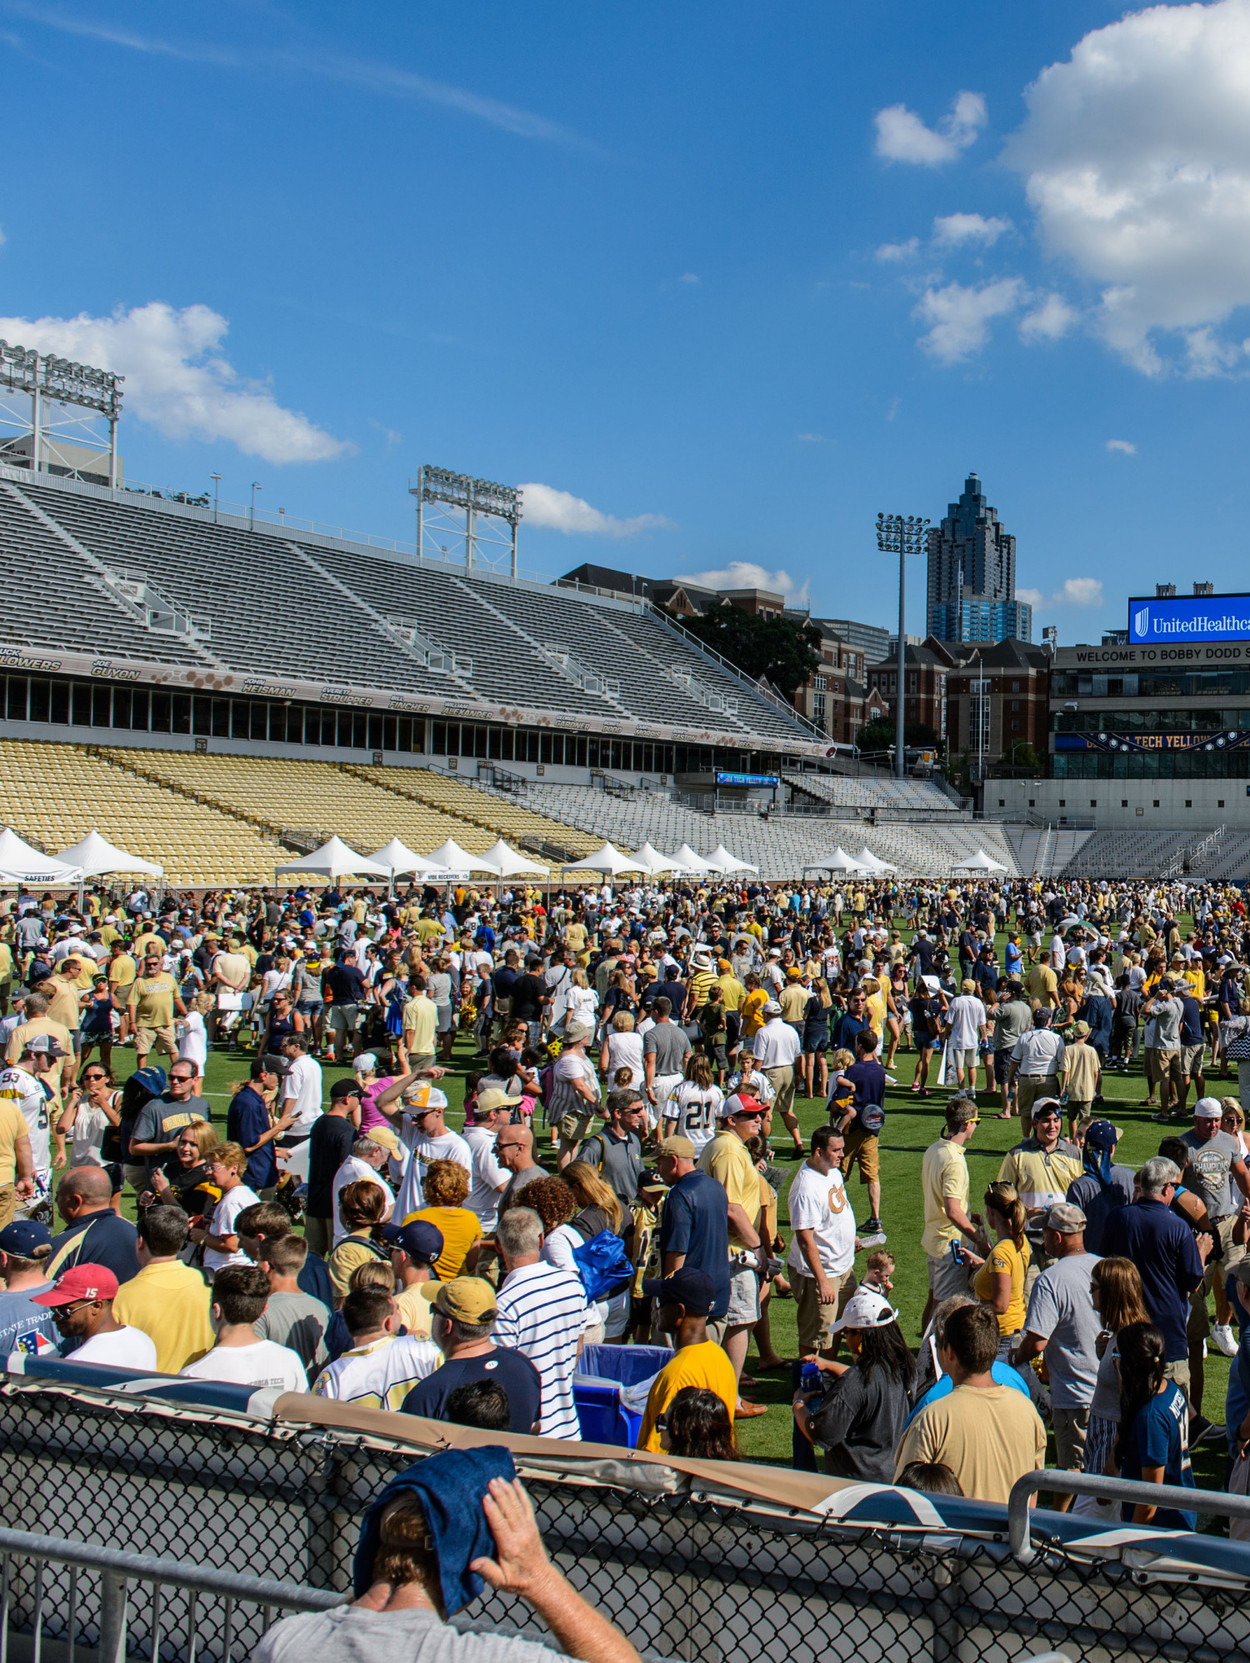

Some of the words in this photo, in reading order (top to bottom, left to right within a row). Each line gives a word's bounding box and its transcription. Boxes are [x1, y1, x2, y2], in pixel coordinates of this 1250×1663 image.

[1077, 652, 1137, 663] WELCOME
[1141, 651, 1157, 661] TO
[1160, 649, 1202, 660] BOBBY
[1205, 648, 1241, 659] DODD
[93, 660, 111, 668] JOE
[91, 666, 140, 680] GUYON
[242, 684, 296, 697] HEISMAN
[1135, 735, 1163, 748] TECH
[2, 1072, 20, 1083] 93
[685, 1101, 712, 1129] 21
